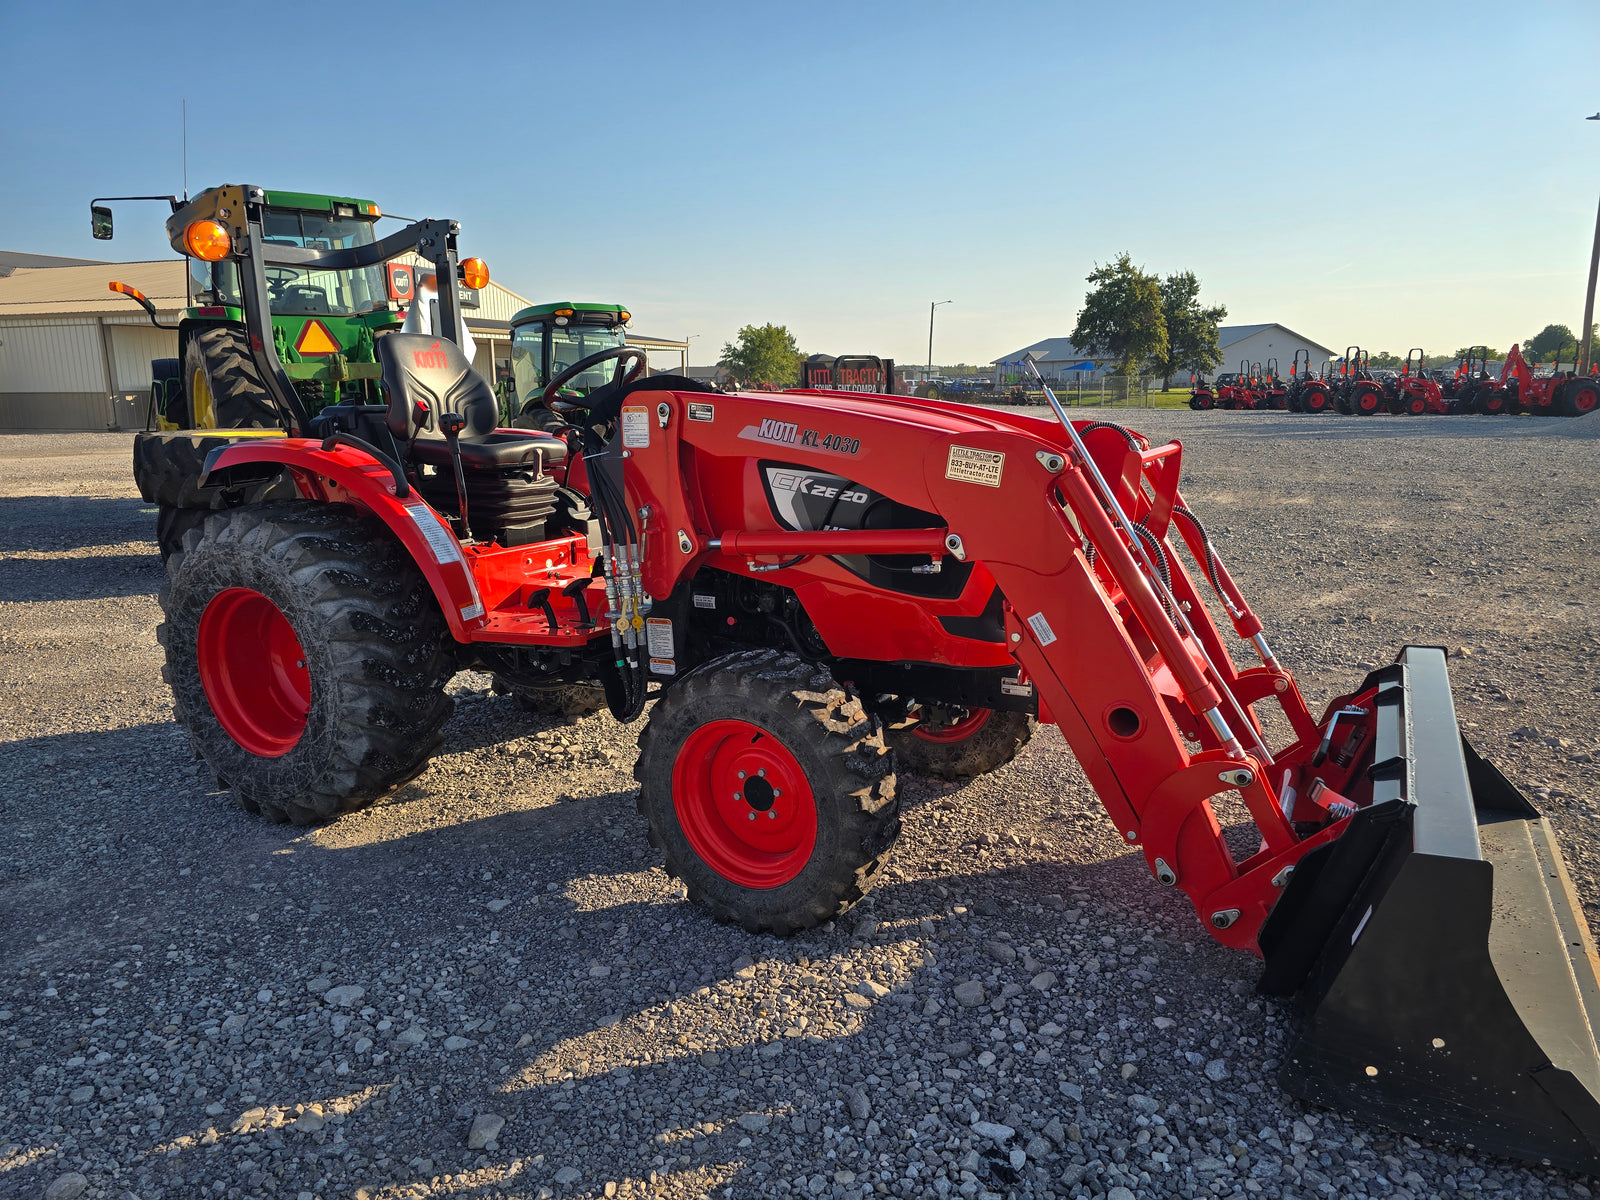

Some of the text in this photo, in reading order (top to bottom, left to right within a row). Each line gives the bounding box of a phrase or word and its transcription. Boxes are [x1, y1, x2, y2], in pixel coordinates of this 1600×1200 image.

[413, 350, 448, 369] KIOTI
[808, 369, 834, 384] LITTL
[758, 418, 861, 455] KIOTI KL 4030
[950, 467, 998, 480] littletractor.com
